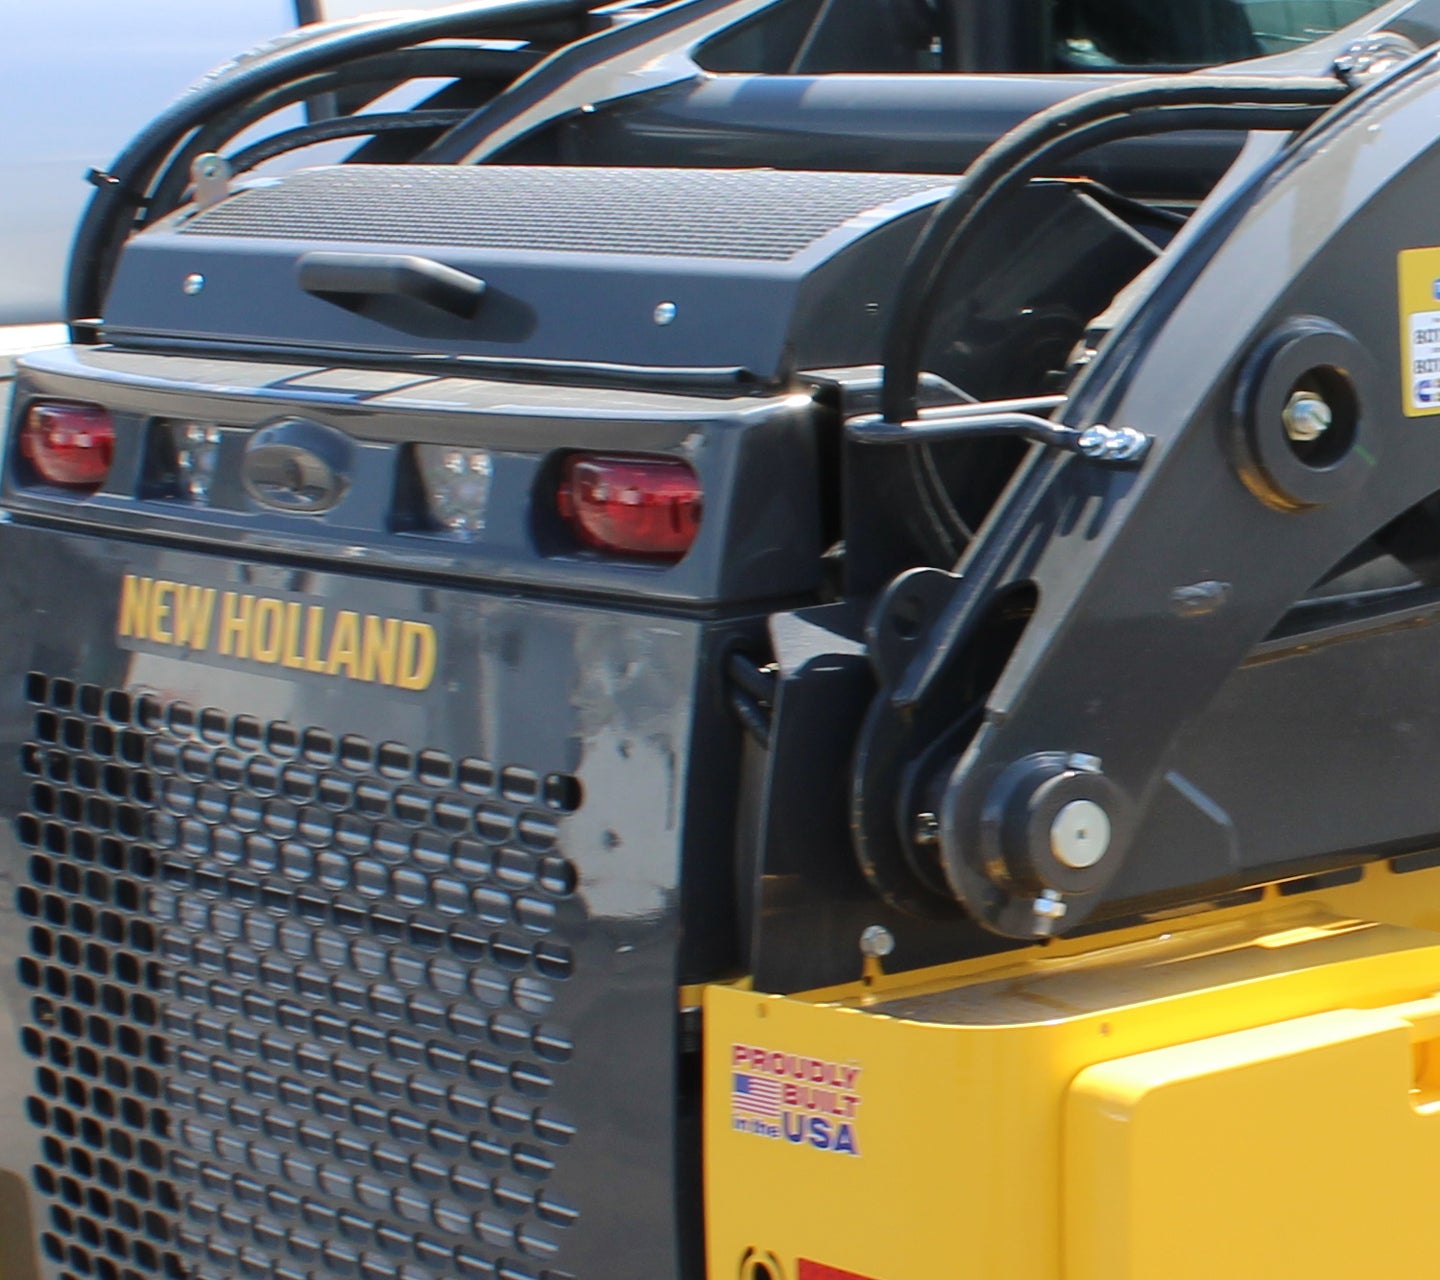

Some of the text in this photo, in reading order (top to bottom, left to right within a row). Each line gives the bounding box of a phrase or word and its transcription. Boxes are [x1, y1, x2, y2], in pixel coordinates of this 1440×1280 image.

[119, 575, 437, 691] NEW HOLLAND
[732, 1045, 861, 1089] PROUDLY
[783, 1083, 861, 1118] BUILT
[782, 1111, 861, 1157] USA
